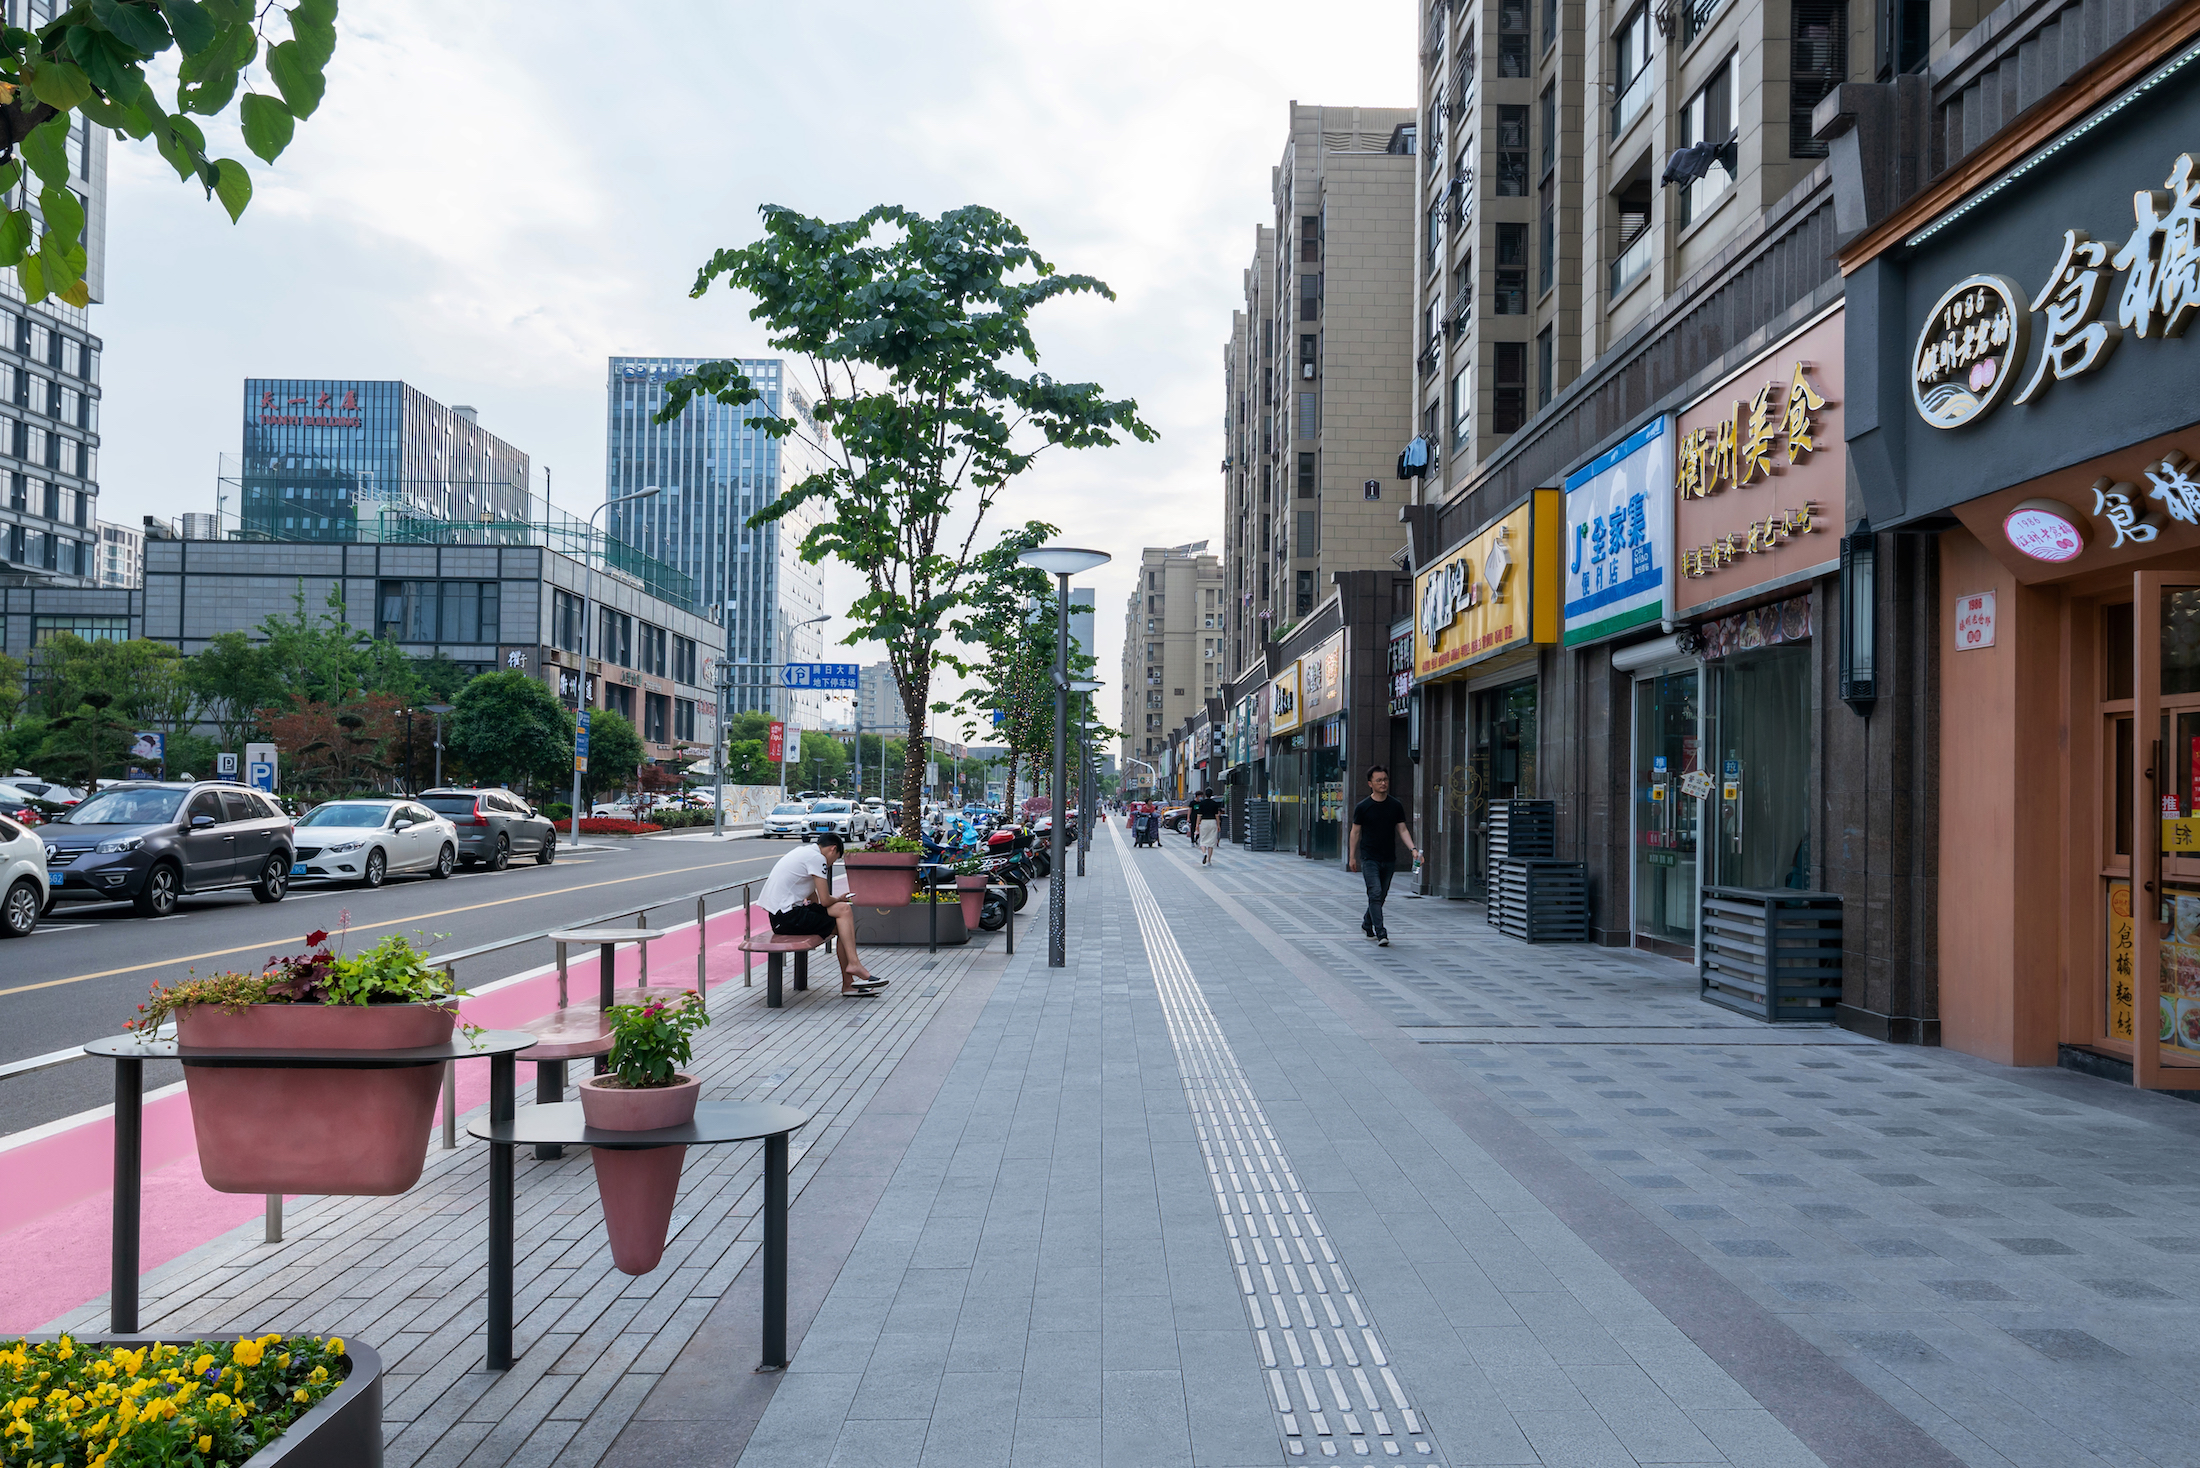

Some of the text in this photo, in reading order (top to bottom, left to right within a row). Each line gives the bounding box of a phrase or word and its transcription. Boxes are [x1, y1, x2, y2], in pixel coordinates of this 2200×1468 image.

[1944, 287, 1985, 331] 1986
[260, 390, 361, 410] 天一大厦
[259, 415, 361, 427] TIANYI BUILDING
[1676, 361, 1825, 500] 衢州美食
[1591, 492, 1646, 564] 全家集
[1746, 500, 1813, 555] 特色小吃
[2017, 516, 2042, 530] 1986
[1581, 557, 1619, 597] 便利店
[1968, 597, 1983, 611] 1986
[812, 678, 856, 688] 地下停车场
[252, 764, 271, 786] P
[2162, 795, 2177, 811] 推
